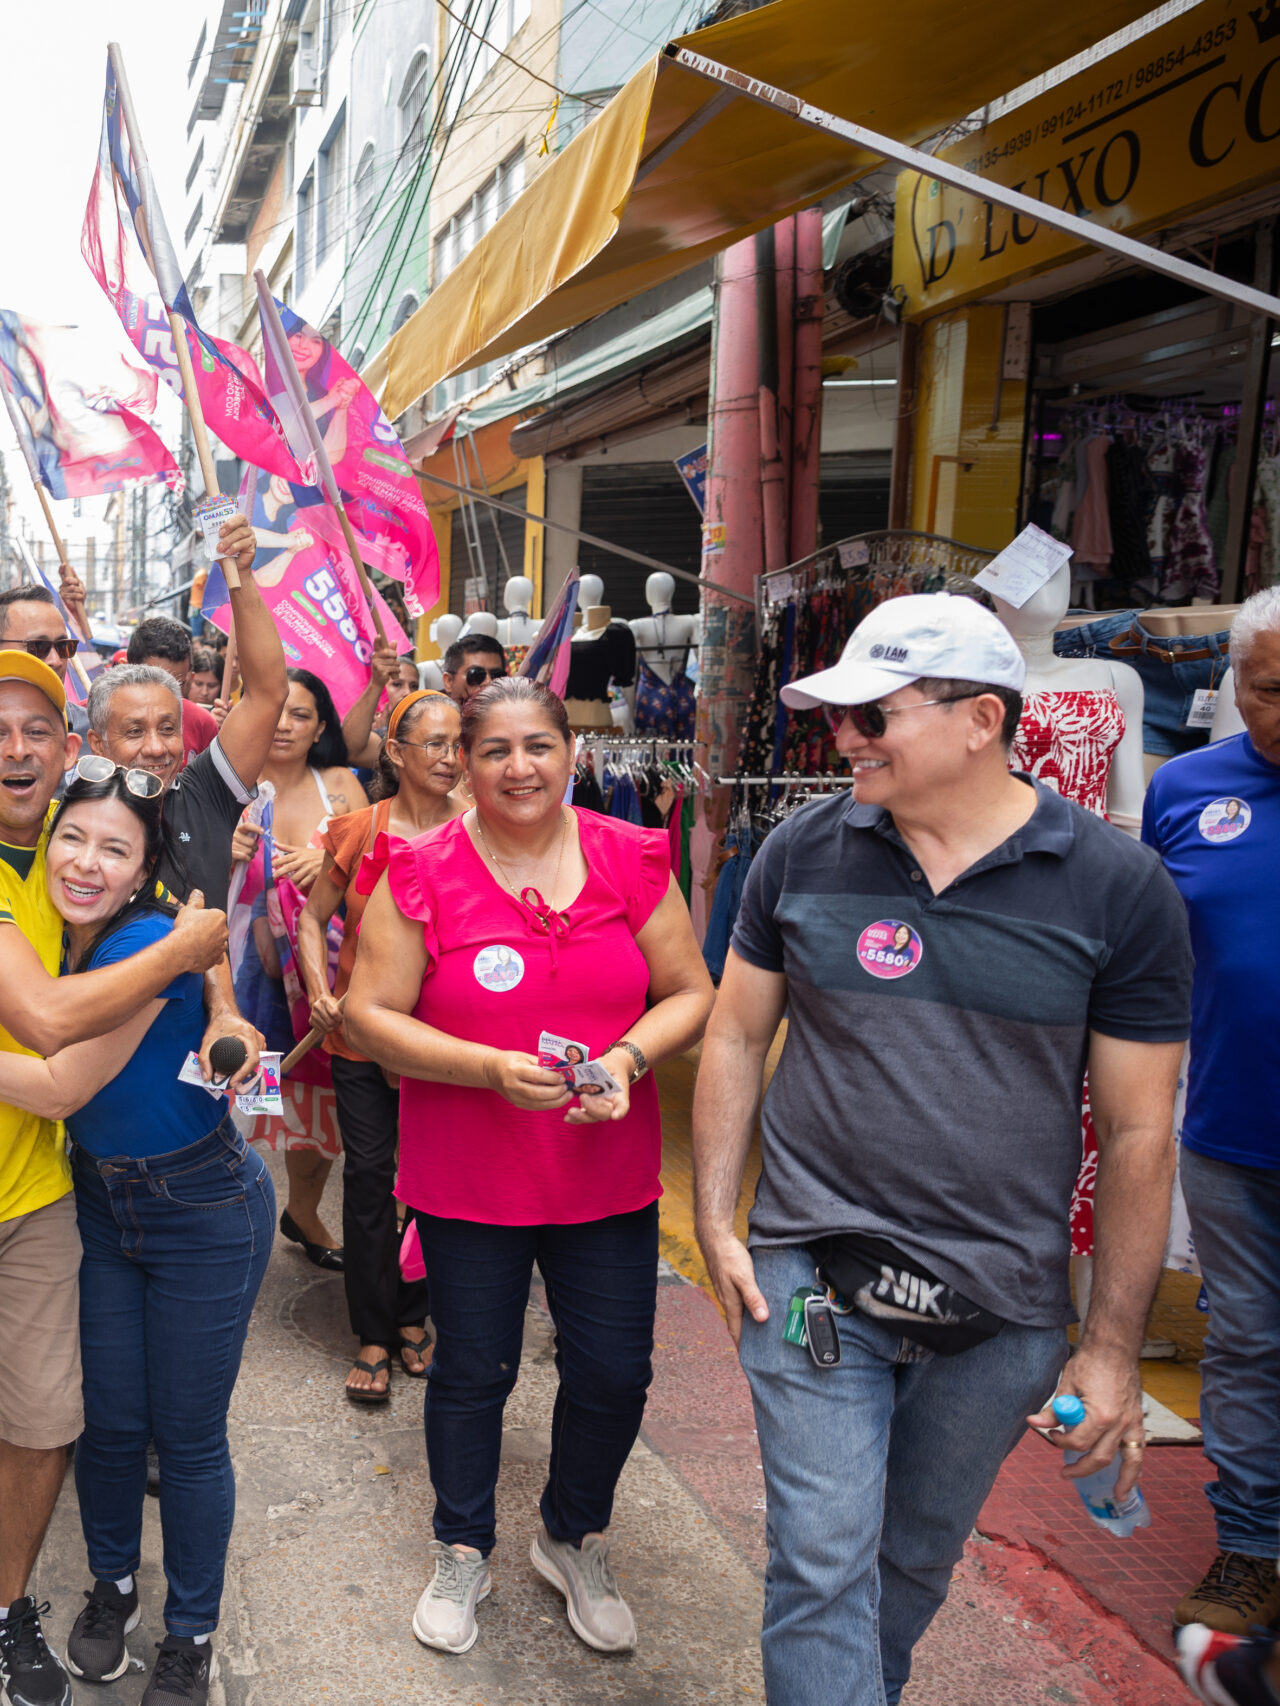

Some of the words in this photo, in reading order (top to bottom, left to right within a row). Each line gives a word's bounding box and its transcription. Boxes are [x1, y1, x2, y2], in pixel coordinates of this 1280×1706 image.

[1041, 79, 1124, 139] 99124-1172
[1134, 17, 1238, 90] 98854-4353
[304, 566, 374, 667] 5580
[891, 646, 909, 660] AM
[866, 948, 904, 967] 5580
